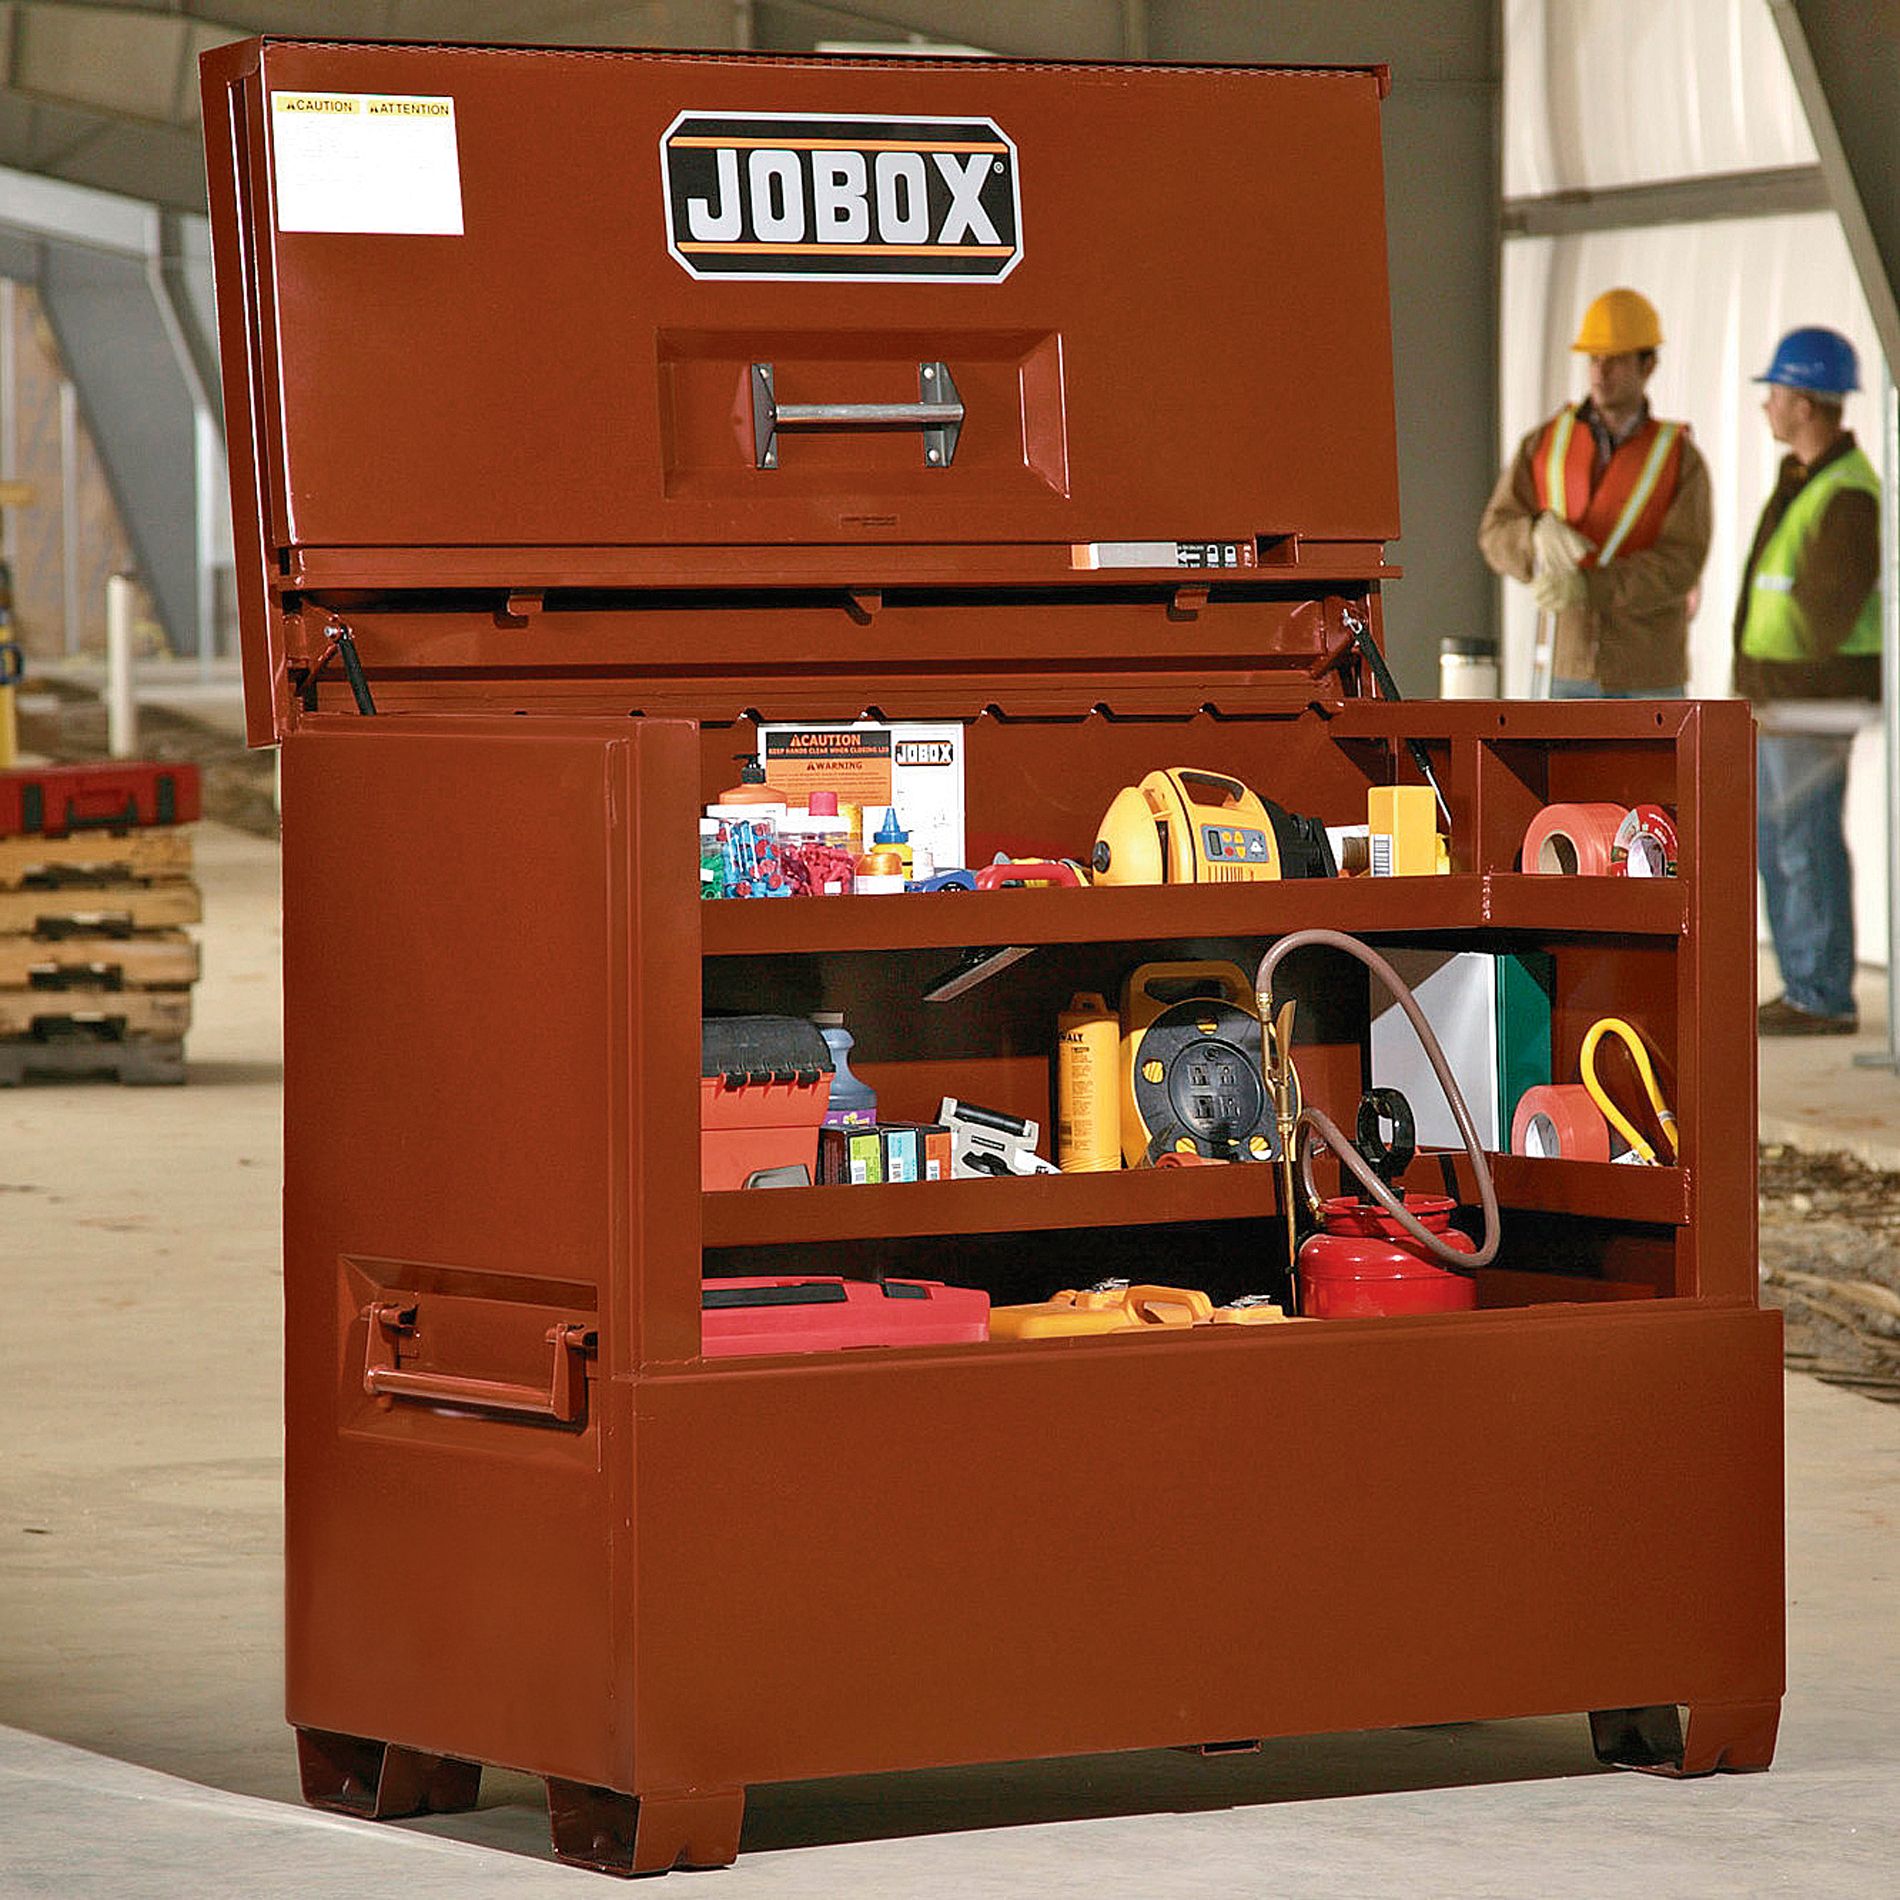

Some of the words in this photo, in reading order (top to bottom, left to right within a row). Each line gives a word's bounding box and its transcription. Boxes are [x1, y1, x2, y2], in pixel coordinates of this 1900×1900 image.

[297, 99, 352, 112] CAUTION
[379, 103, 449, 115] ATTENTION
[687, 148, 1002, 244] JOBOX
[801, 734, 861, 747] CAUTION
[786, 747, 807, 755] HANDS
[809, 747, 828, 755] CLEAR
[897, 743, 951, 763] JOBOX
[817, 761, 863, 770] WARNING
